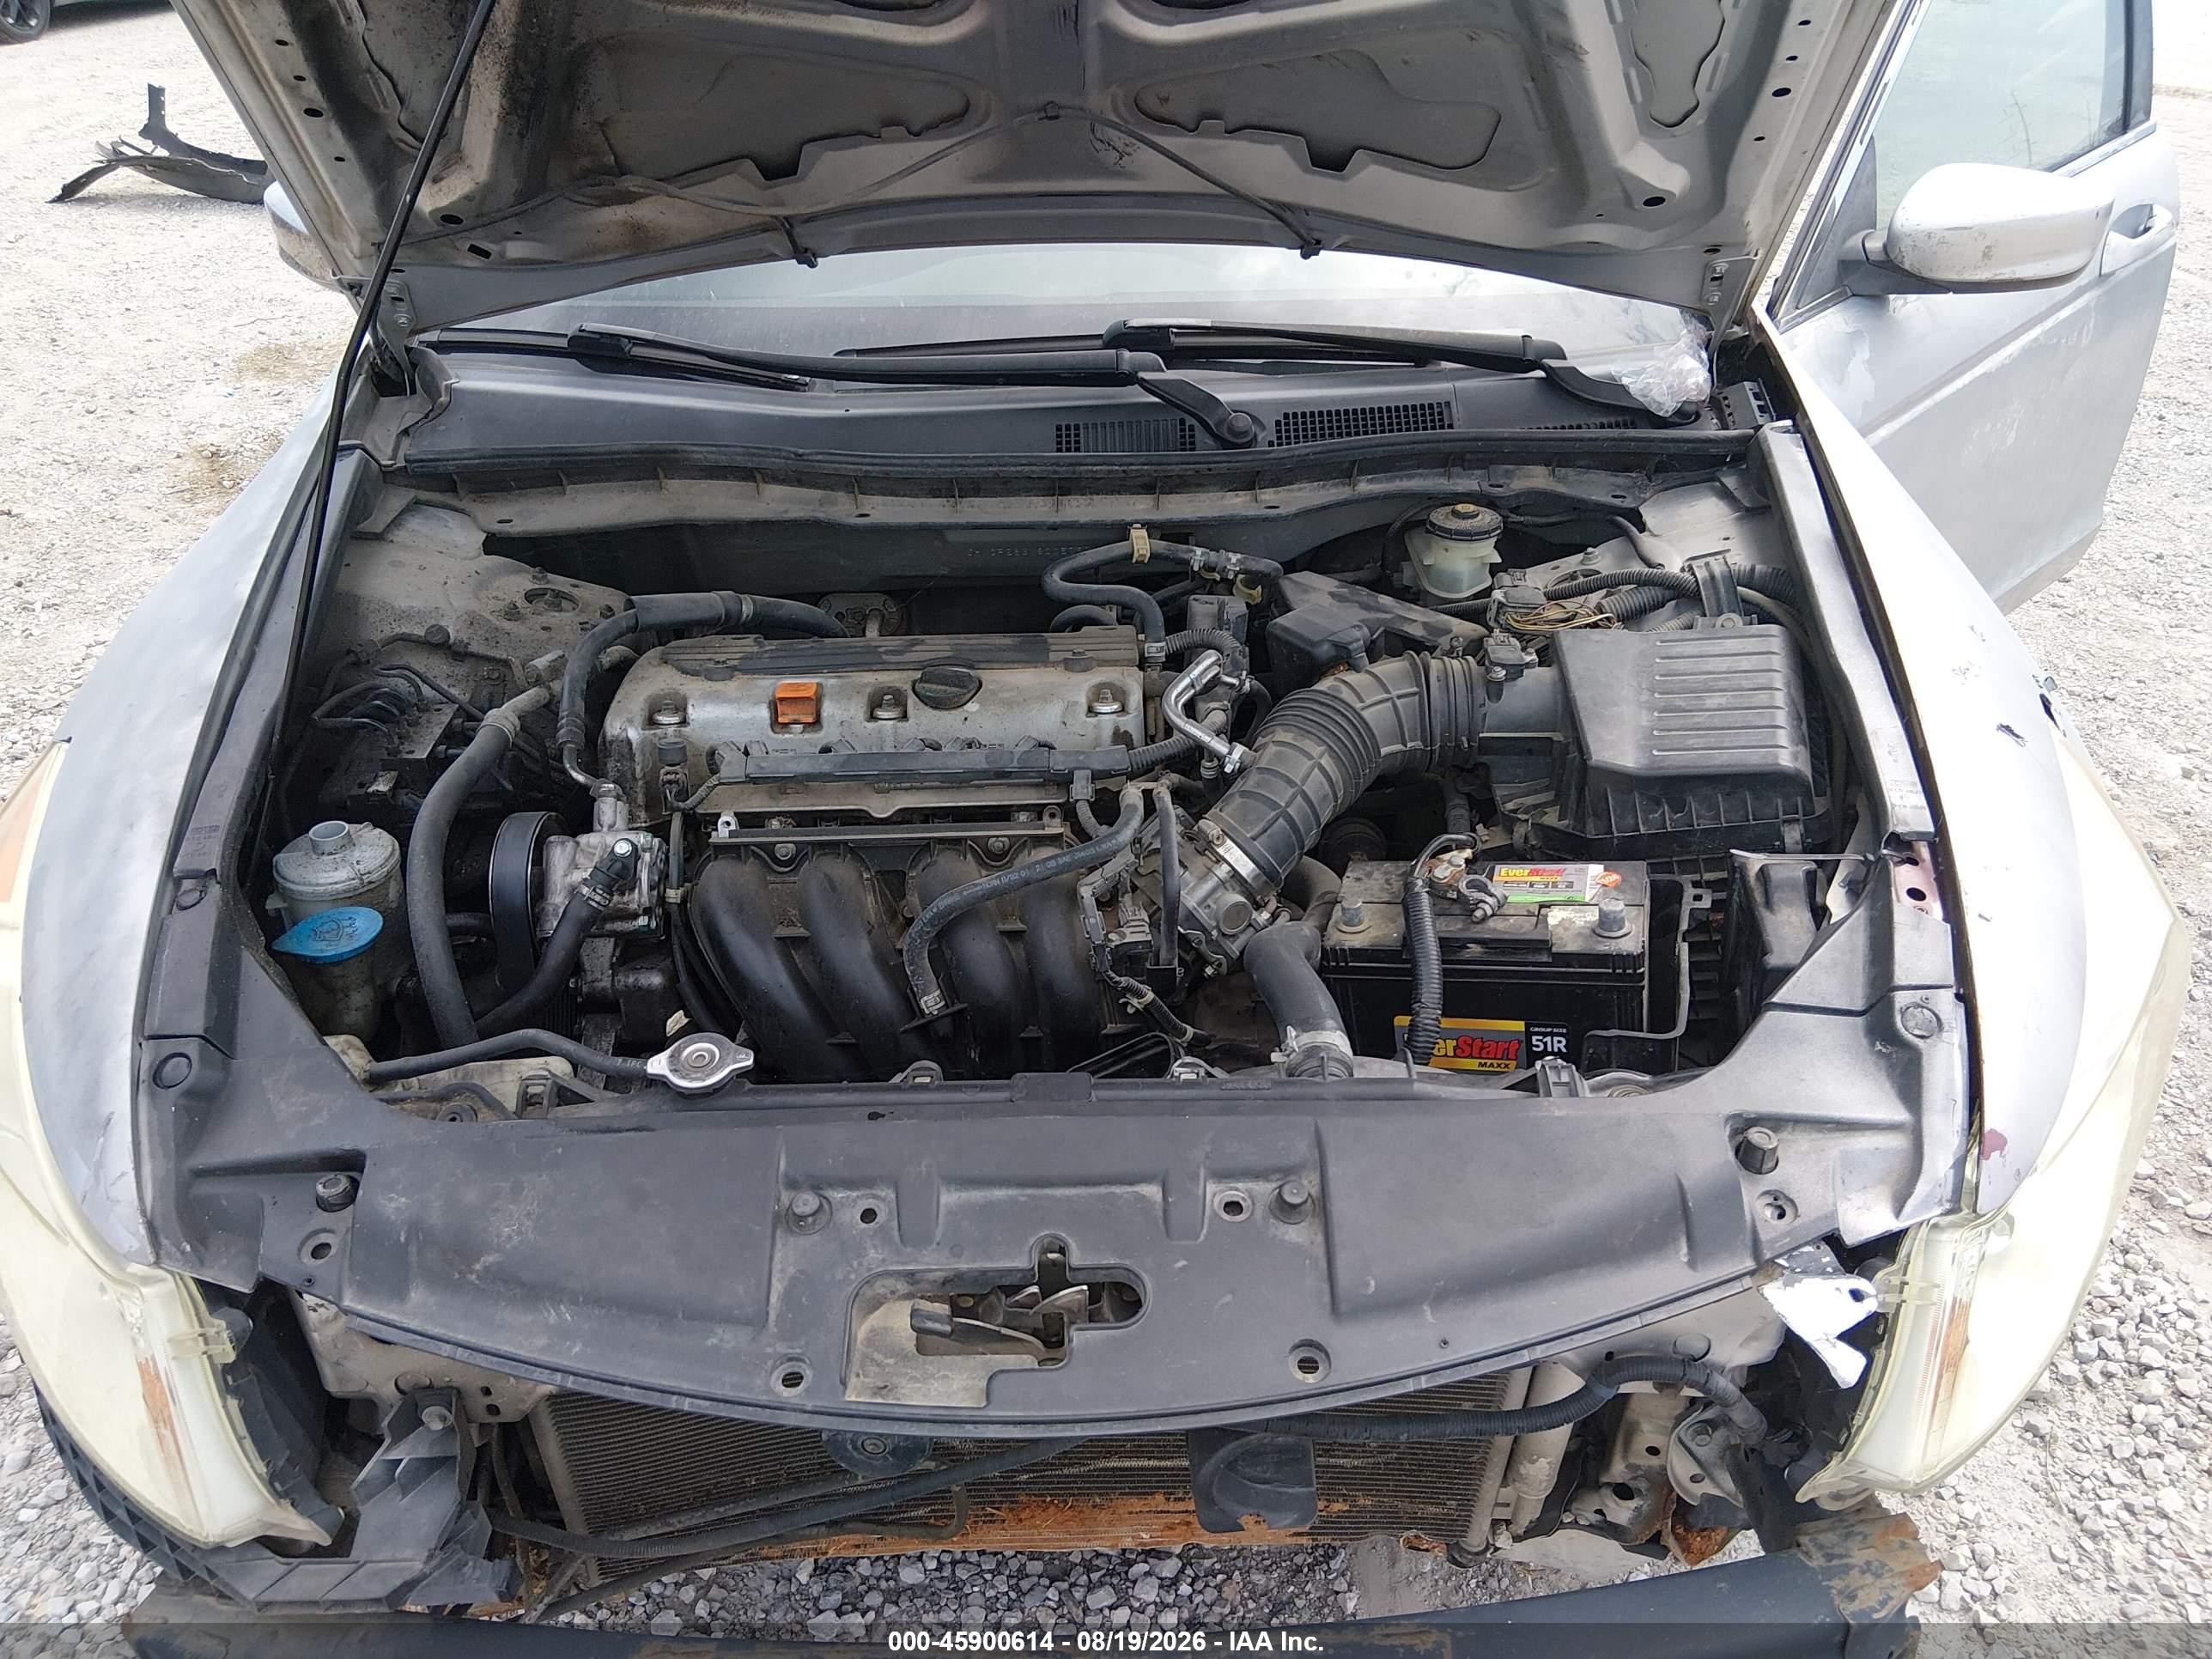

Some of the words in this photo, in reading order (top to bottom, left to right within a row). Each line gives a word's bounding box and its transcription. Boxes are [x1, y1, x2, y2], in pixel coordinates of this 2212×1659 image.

[1403, 1034, 1520, 1060] erStart
[1531, 1035, 1567, 1053] 51R
[1478, 1061, 1510, 1070] MAXX
